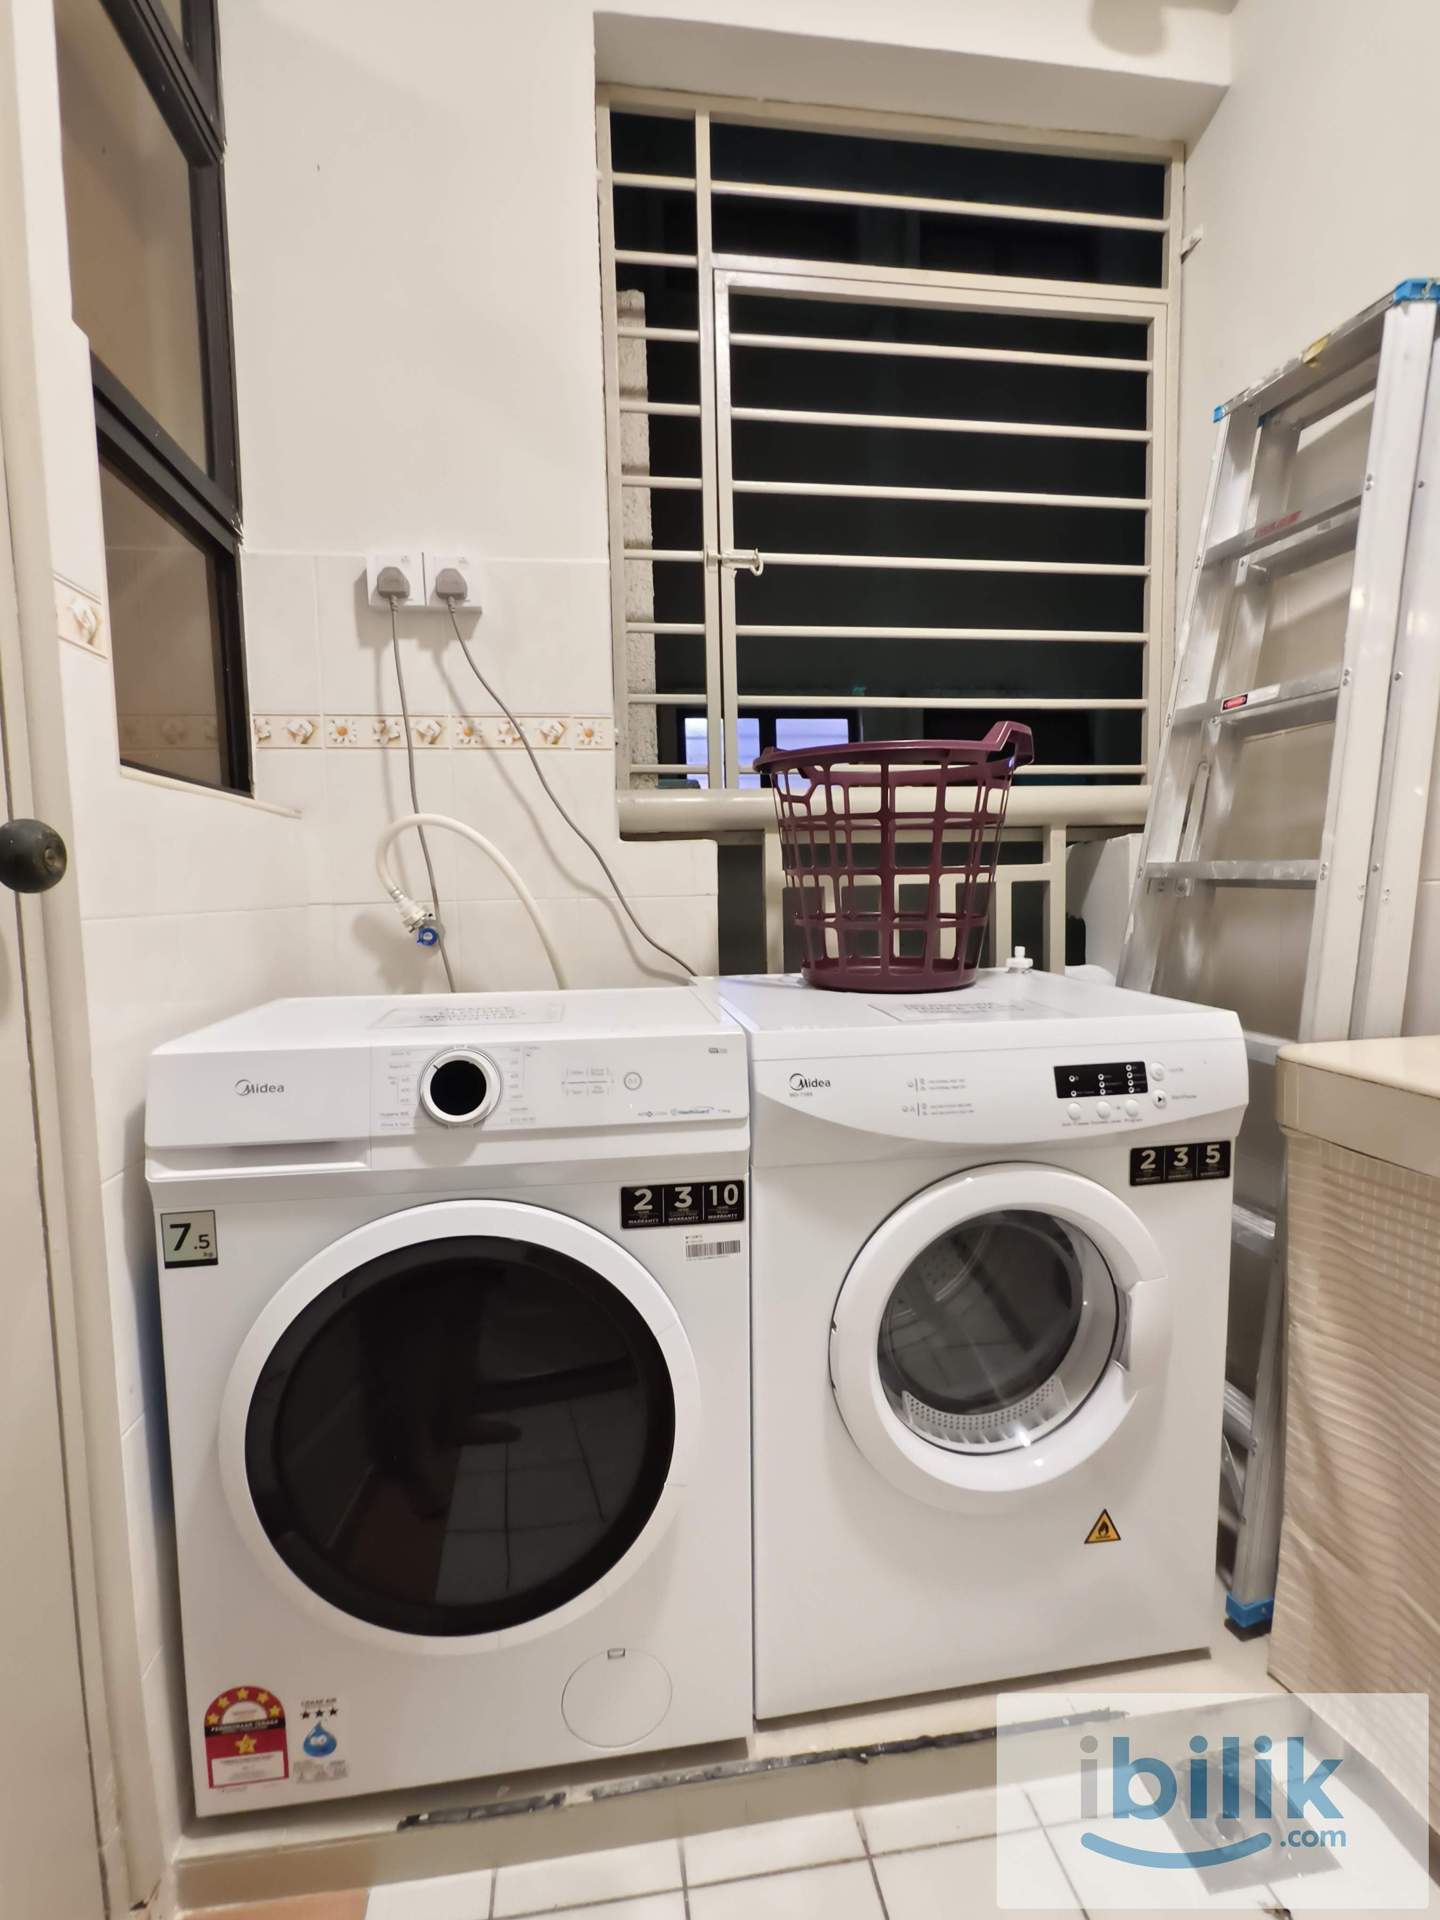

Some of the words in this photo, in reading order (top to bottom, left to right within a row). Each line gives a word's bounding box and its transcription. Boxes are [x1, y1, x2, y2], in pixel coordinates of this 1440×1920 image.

[234, 1079, 285, 1097] Midea
[789, 1073, 831, 1091] Midea
[1140, 1149, 1156, 1169] 2
[1173, 1147, 1188, 1167] 3
[1205, 1144, 1221, 1164] 5
[633, 1188, 653, 1211] 2
[674, 1186, 692, 1208] 3
[708, 1183, 739, 1206] 10
